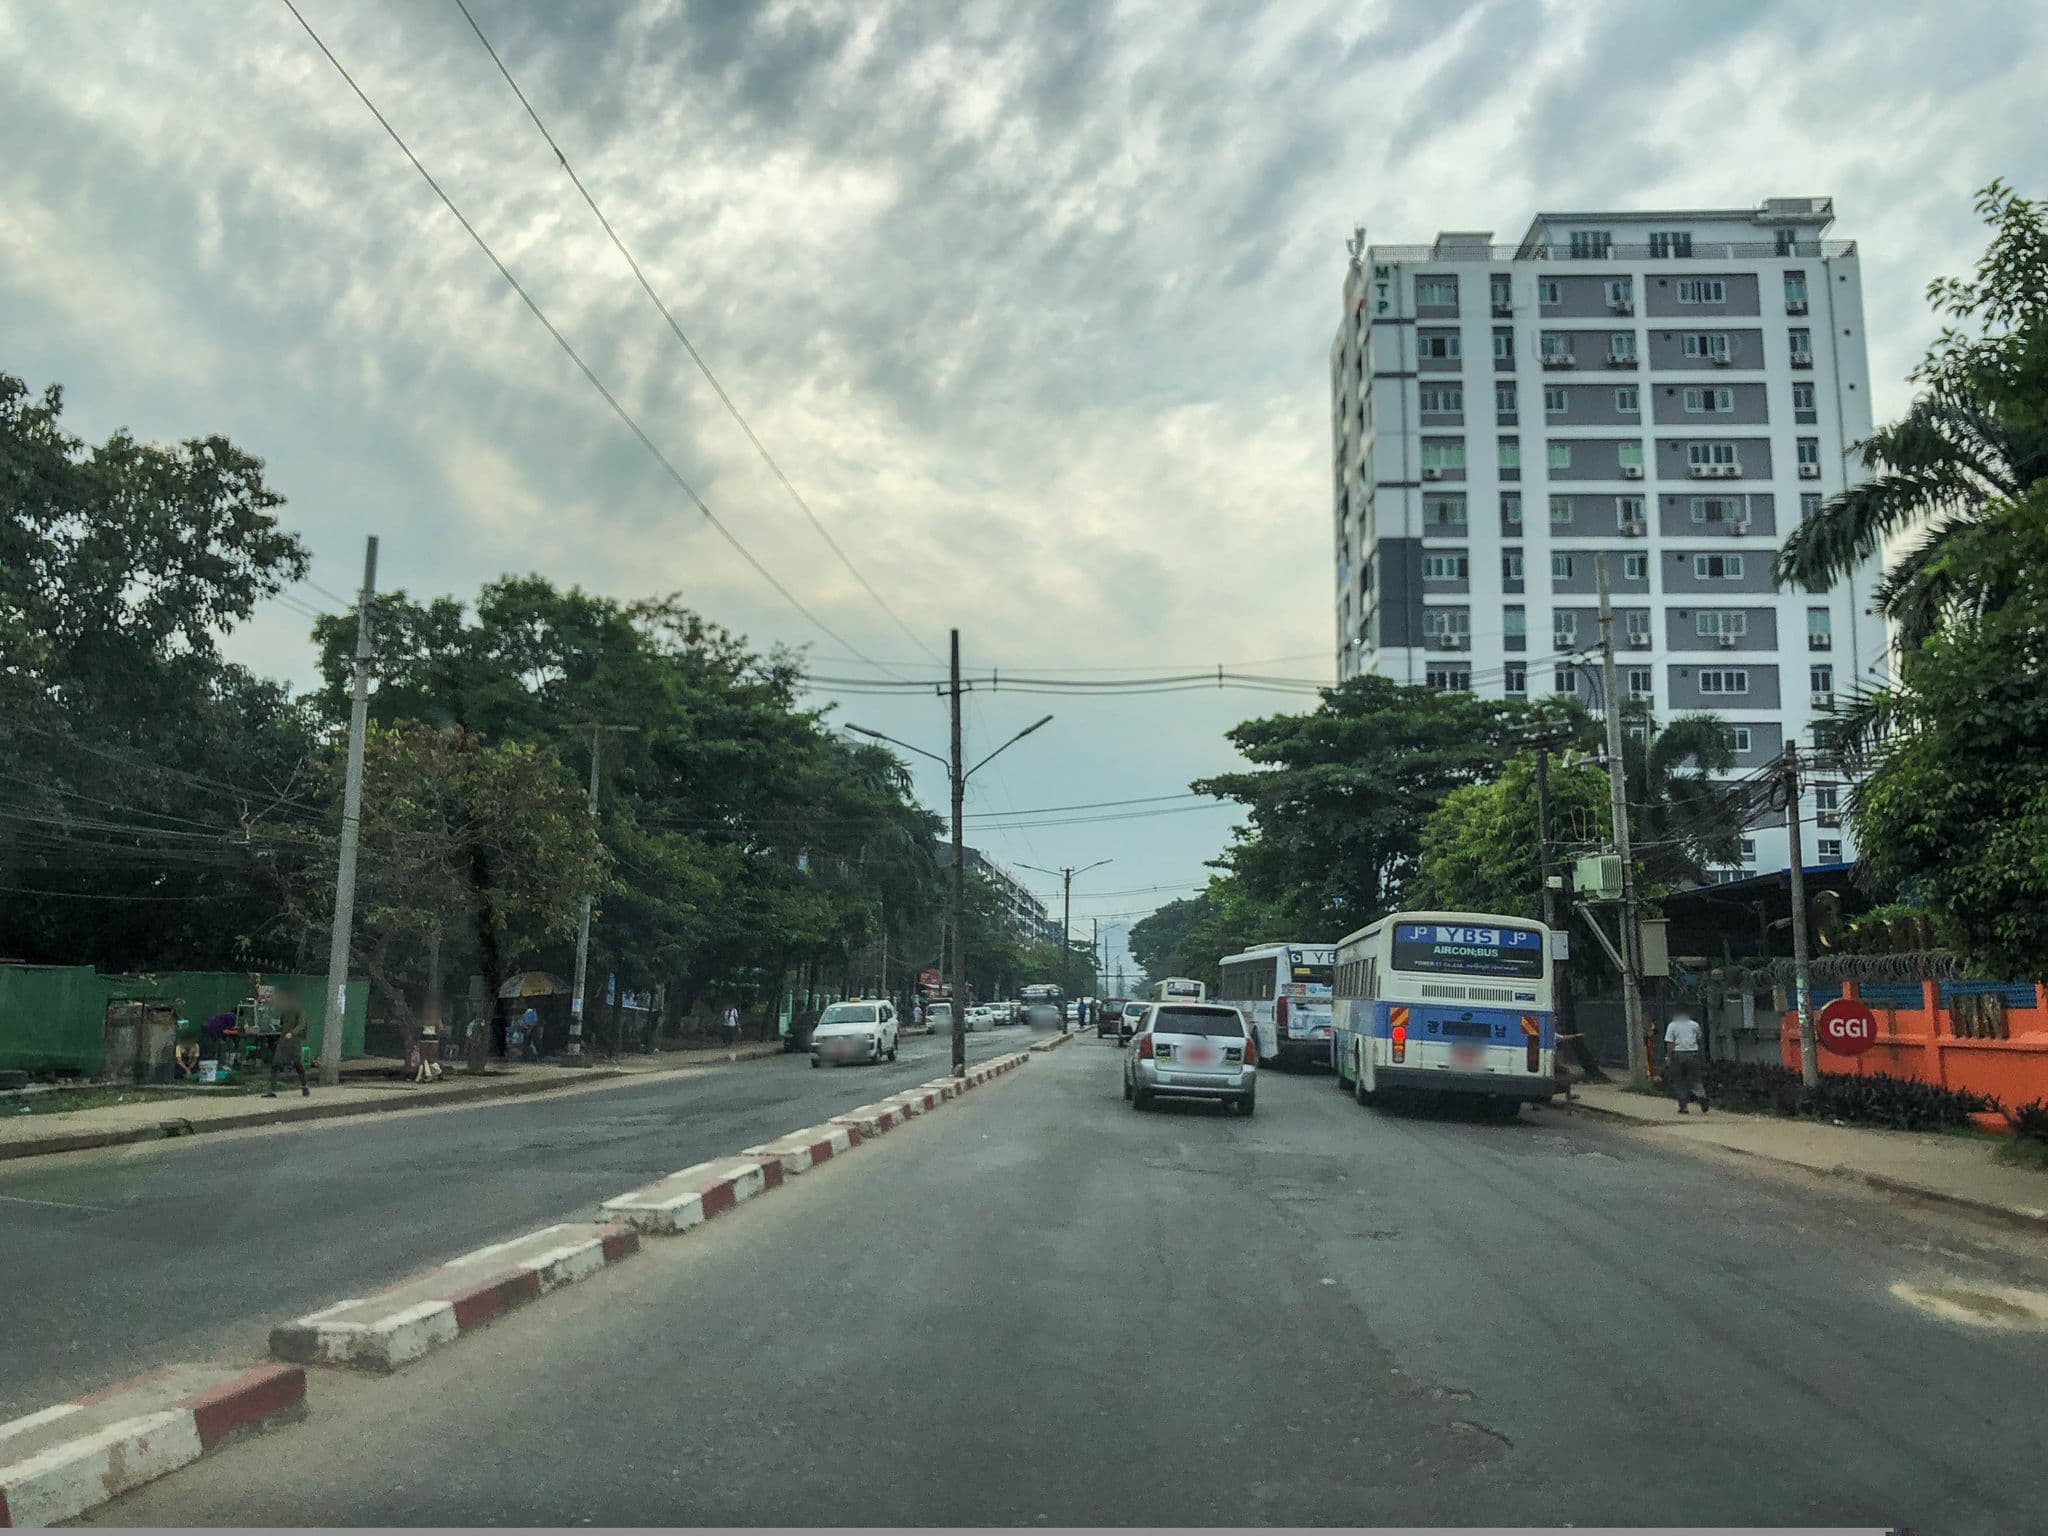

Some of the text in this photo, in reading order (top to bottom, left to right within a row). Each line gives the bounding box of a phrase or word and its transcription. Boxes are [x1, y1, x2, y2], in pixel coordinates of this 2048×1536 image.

[1375, 266, 1389, 315] MTP
[1446, 928, 1492, 944] YBS
[1829, 1018, 1867, 1038] GGI
